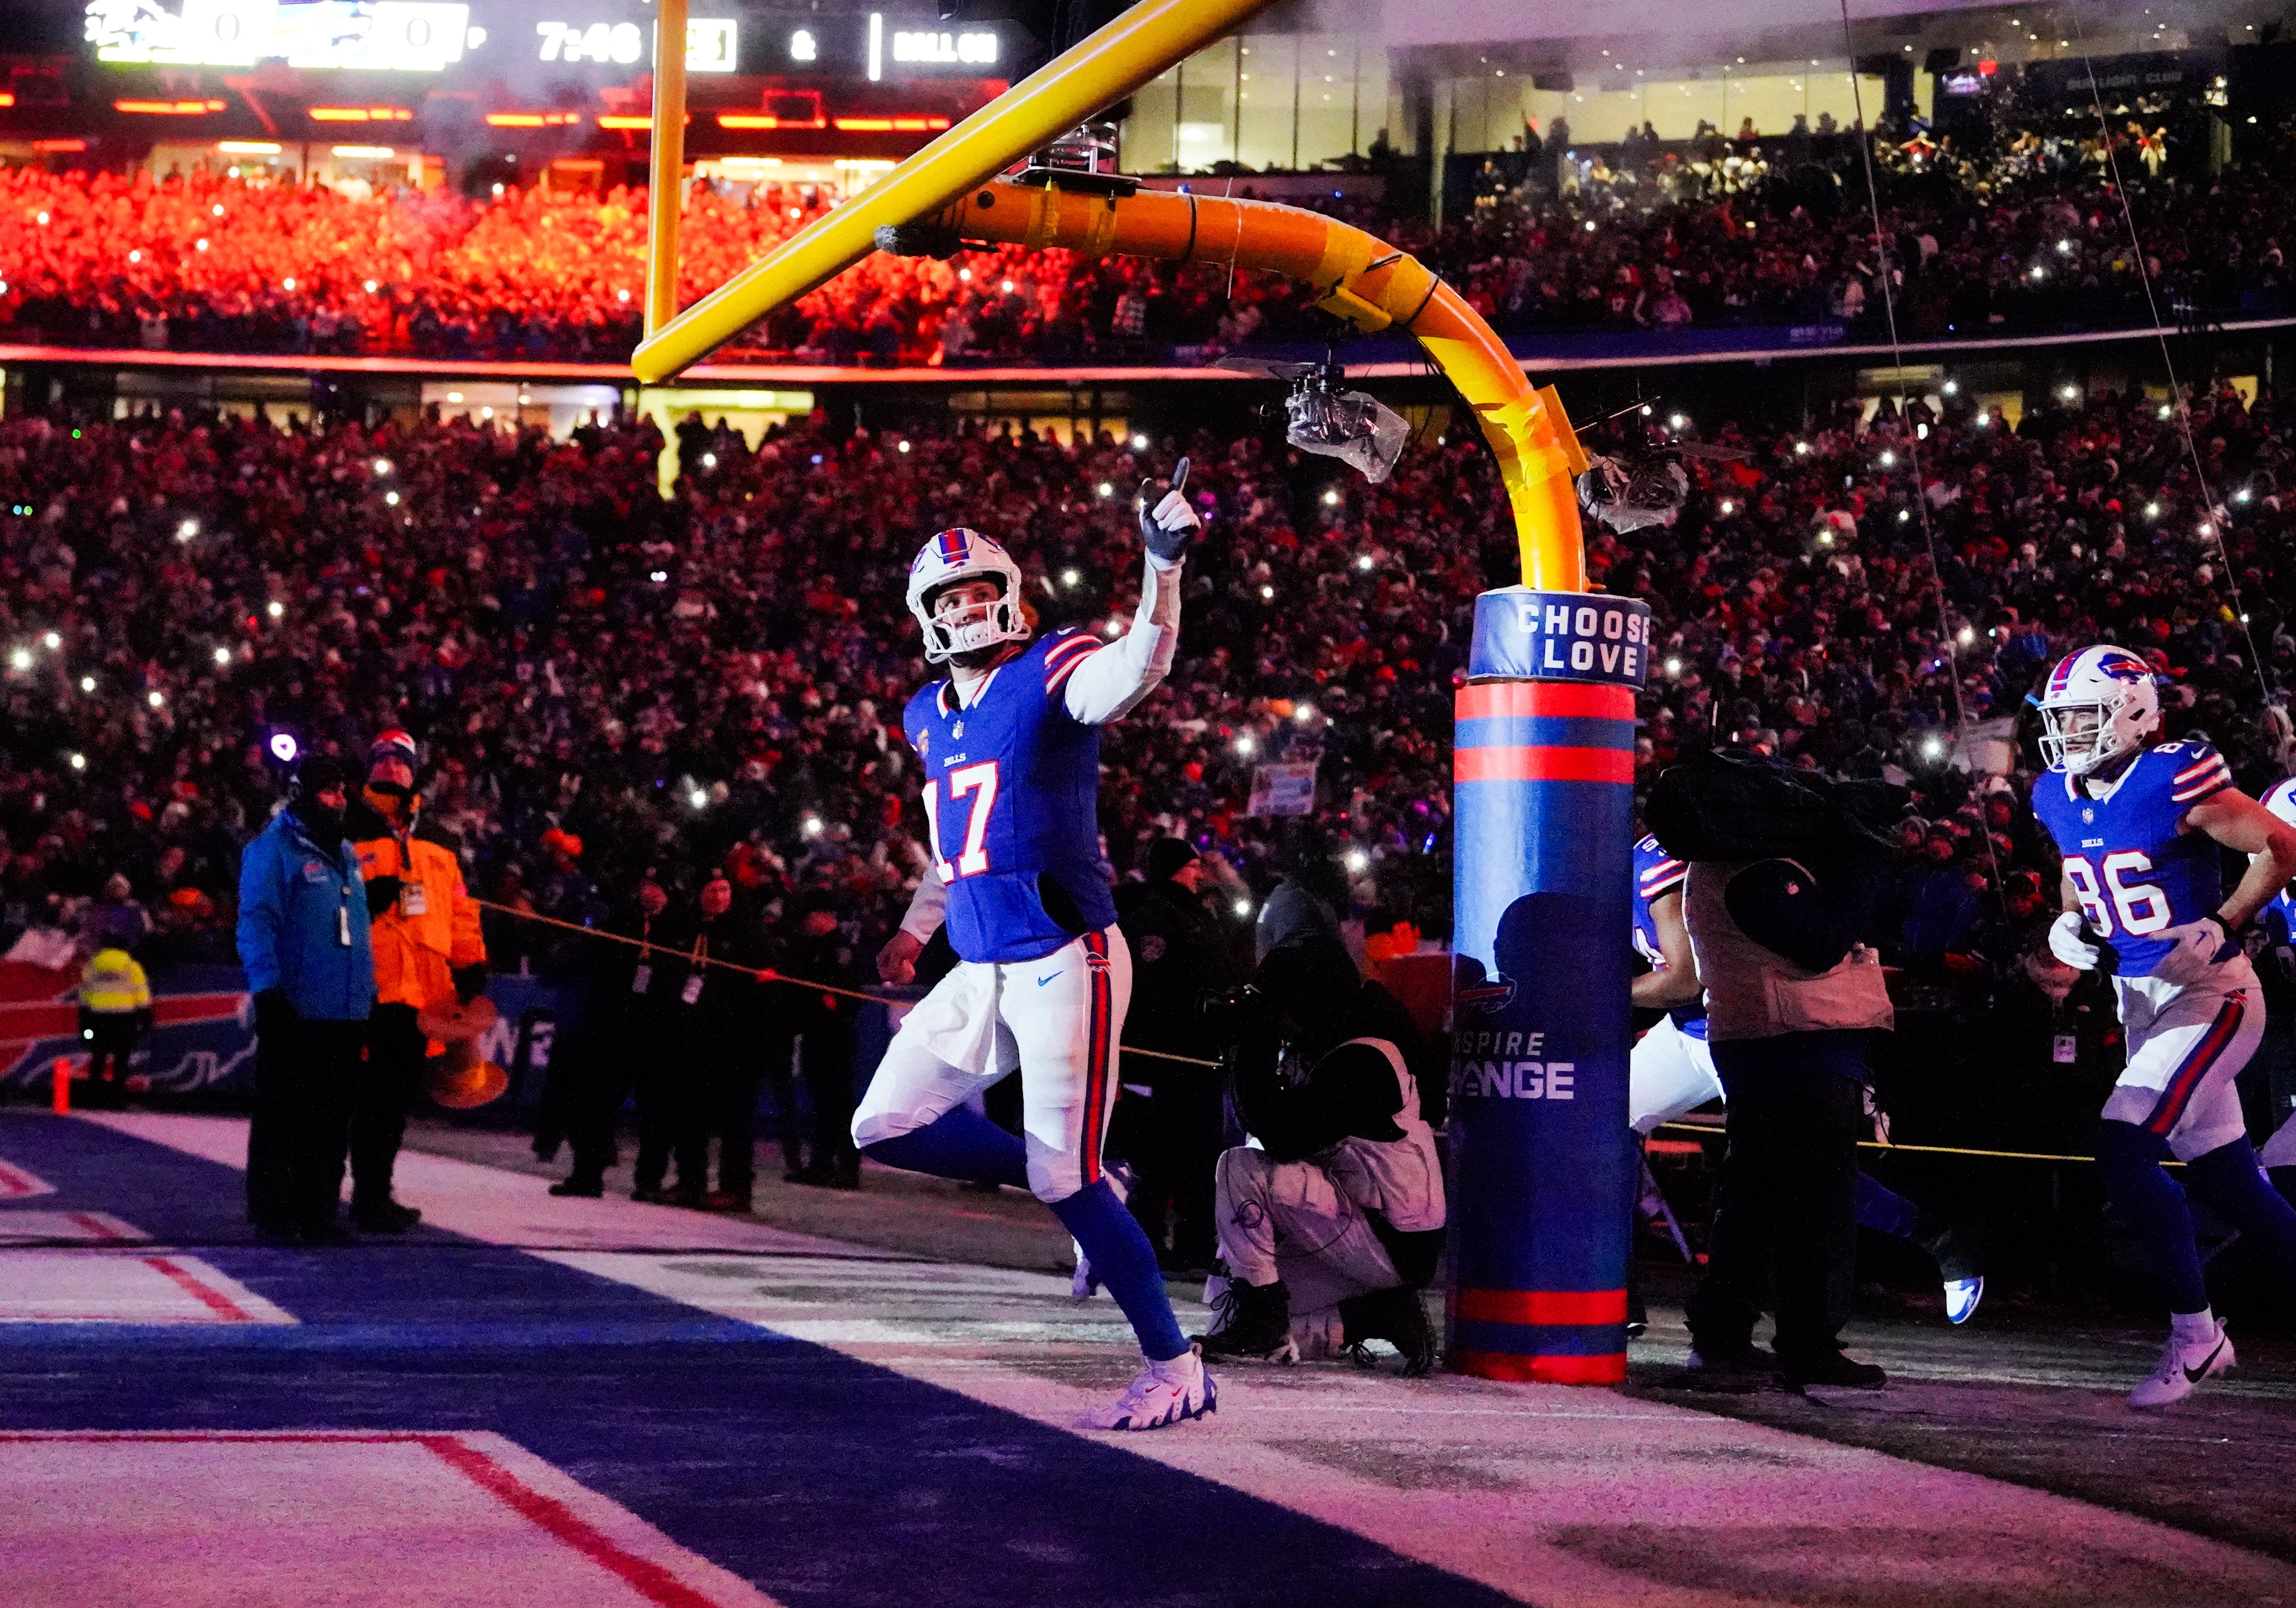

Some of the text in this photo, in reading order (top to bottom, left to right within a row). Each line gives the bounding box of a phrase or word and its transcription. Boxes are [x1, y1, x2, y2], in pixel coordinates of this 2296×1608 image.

[1518, 604, 1650, 646] CHOOSE
[1544, 639, 1638, 677] LOVE
[944, 752, 967, 767] BILLS
[921, 760, 999, 886] 17
[2081, 838, 2104, 848] BILLS
[2062, 851, 2172, 939] 86
